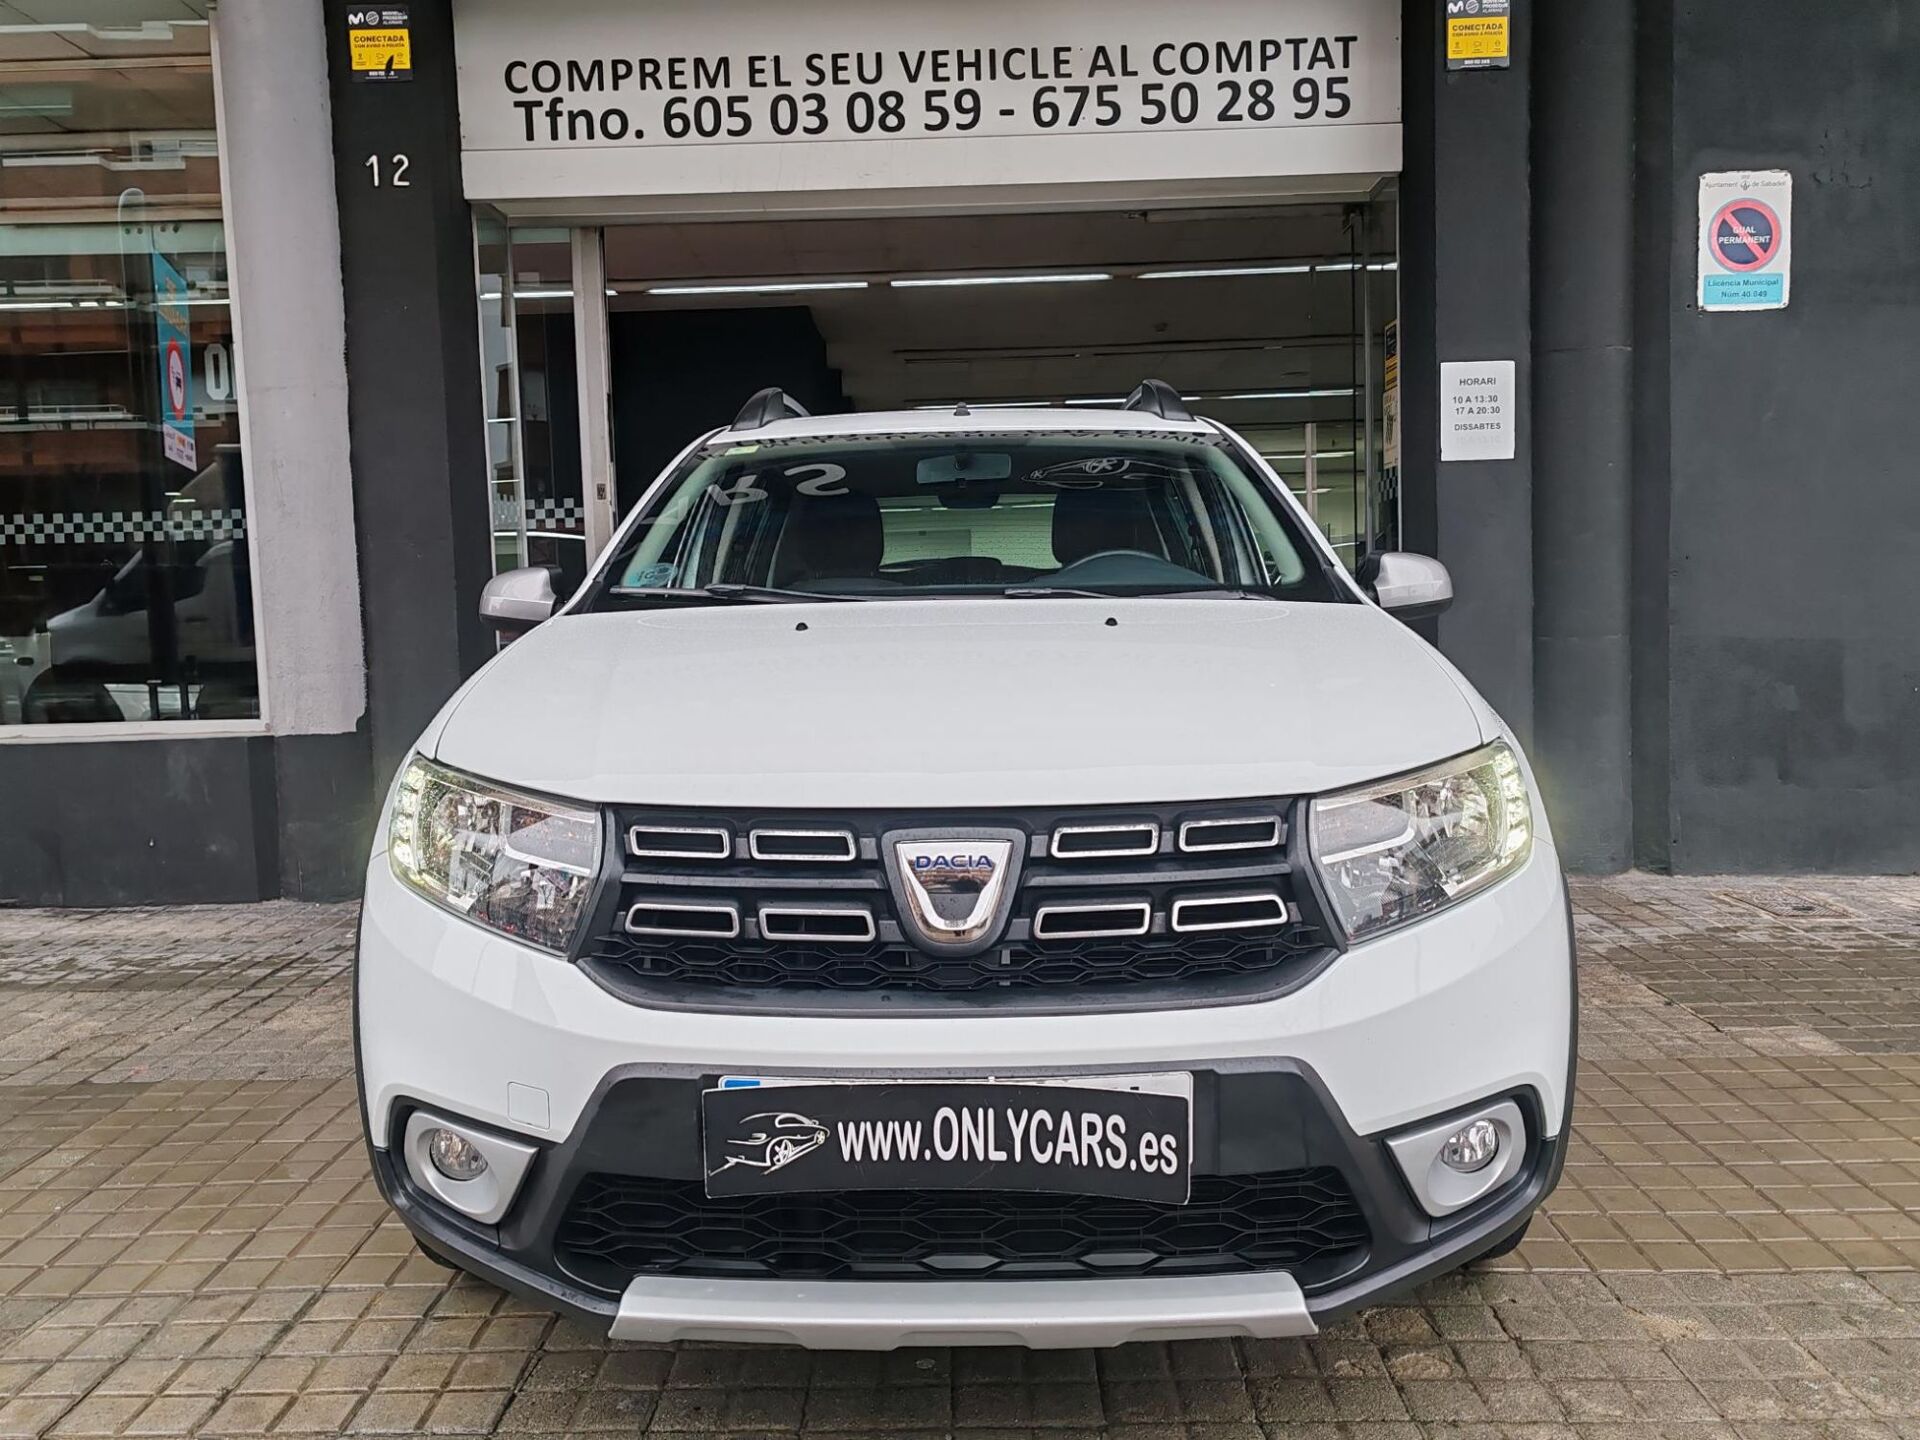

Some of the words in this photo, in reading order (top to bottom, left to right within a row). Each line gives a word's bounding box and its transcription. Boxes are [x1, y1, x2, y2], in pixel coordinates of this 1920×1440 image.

[1452, 23, 1504, 31] CONECTADA
[354, 35, 405, 43] CONECTADA
[504, 55, 731, 94] COMPREM
[748, 54, 792, 88] EL
[804, 51, 883, 87] SEU
[899, 46, 1073, 83] VEHICLE
[1088, 44, 1139, 78] AL
[1152, 35, 1358, 76] COMPTAT
[512, 97, 645, 142] Tfno.
[663, 95, 752, 139] 605
[769, 93, 829, 136] 03
[846, 90, 906, 134] 08
[923, 88, 981, 132] 59
[1032, 84, 1121, 128] 675
[1140, 81, 1199, 126] 50
[1216, 78, 1276, 123] 28
[1292, 75, 1351, 121] 95
[365, 153, 411, 188] 12
[1732, 225, 1757, 235] GUAL
[1718, 234, 1771, 245] PERMANENT
[1742, 278, 1780, 289] Municipal
[1459, 377, 1497, 386] HORARI
[1452, 395, 1463, 404] 10
[1464, 395, 1472, 404] A
[1474, 394, 1499, 403] 13:30
[1455, 406, 1465, 415] 17
[1467, 406, 1475, 415] A
[1476, 405, 1501, 414] 20:30
[1454, 422, 1502, 431] DISSABTES
[915, 855, 993, 869] DACIA
[837, 1106, 1179, 1175] www.ONLYCARS.es
